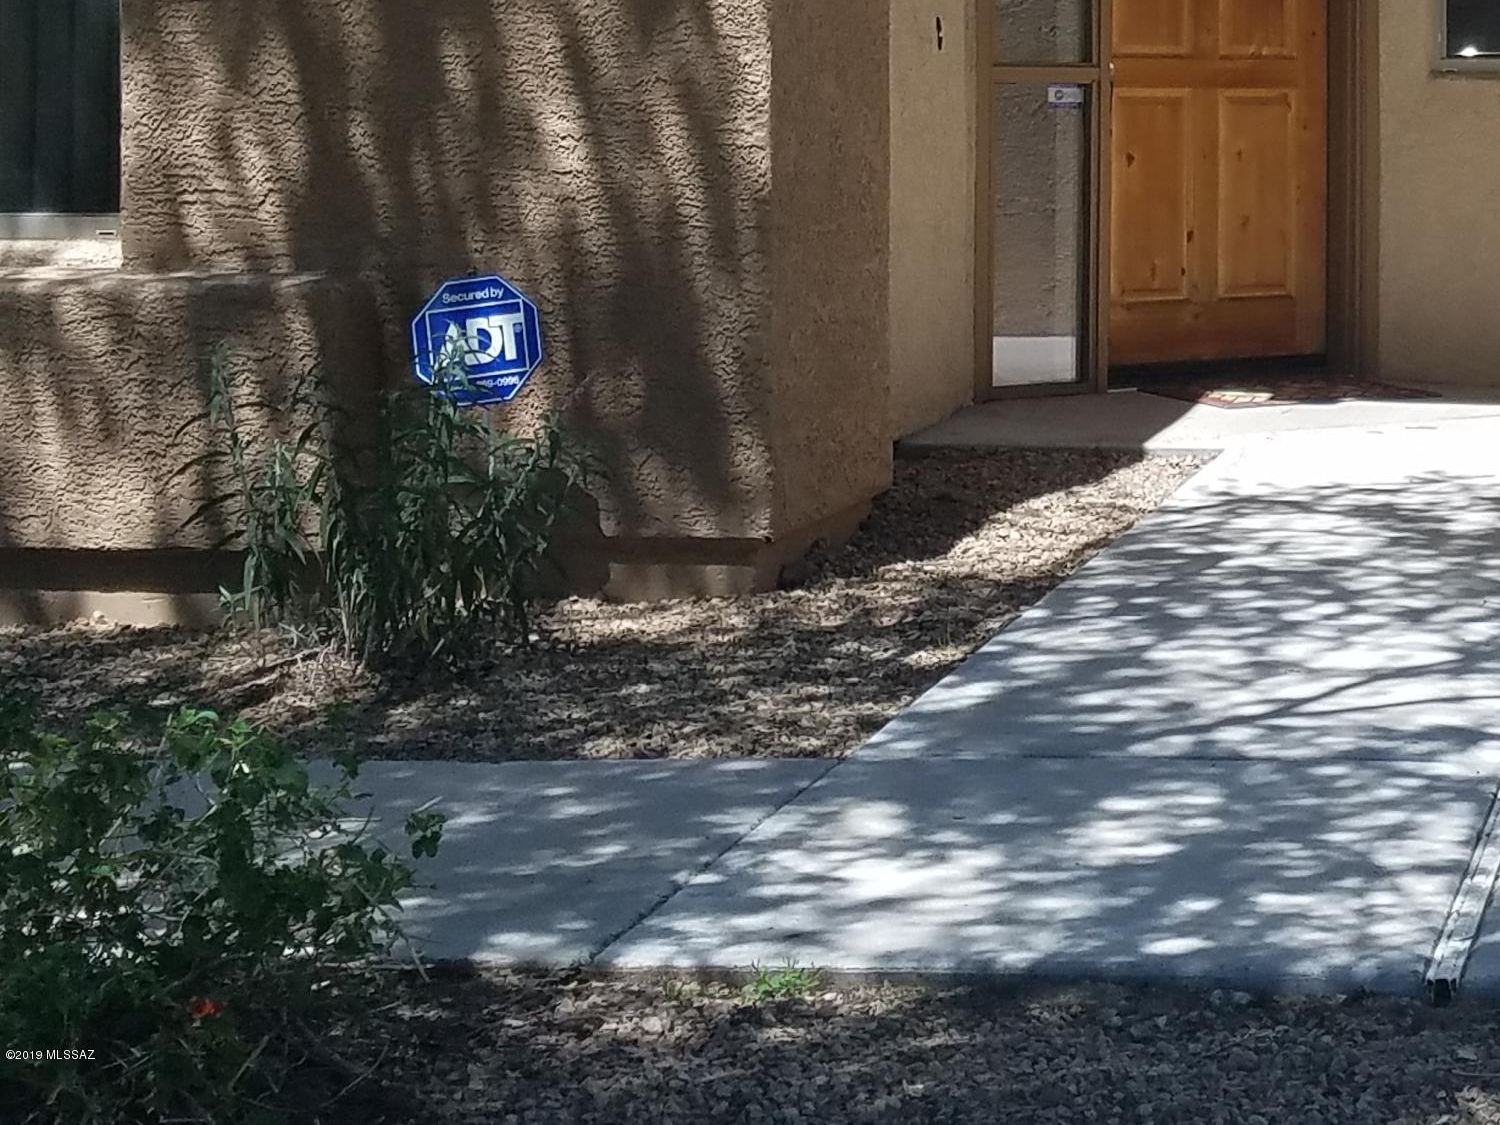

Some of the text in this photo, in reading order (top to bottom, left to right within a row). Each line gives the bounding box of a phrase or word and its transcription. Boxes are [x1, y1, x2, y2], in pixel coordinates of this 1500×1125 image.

[442, 286, 504, 303] Secured by
[434, 313, 523, 371] ADT
